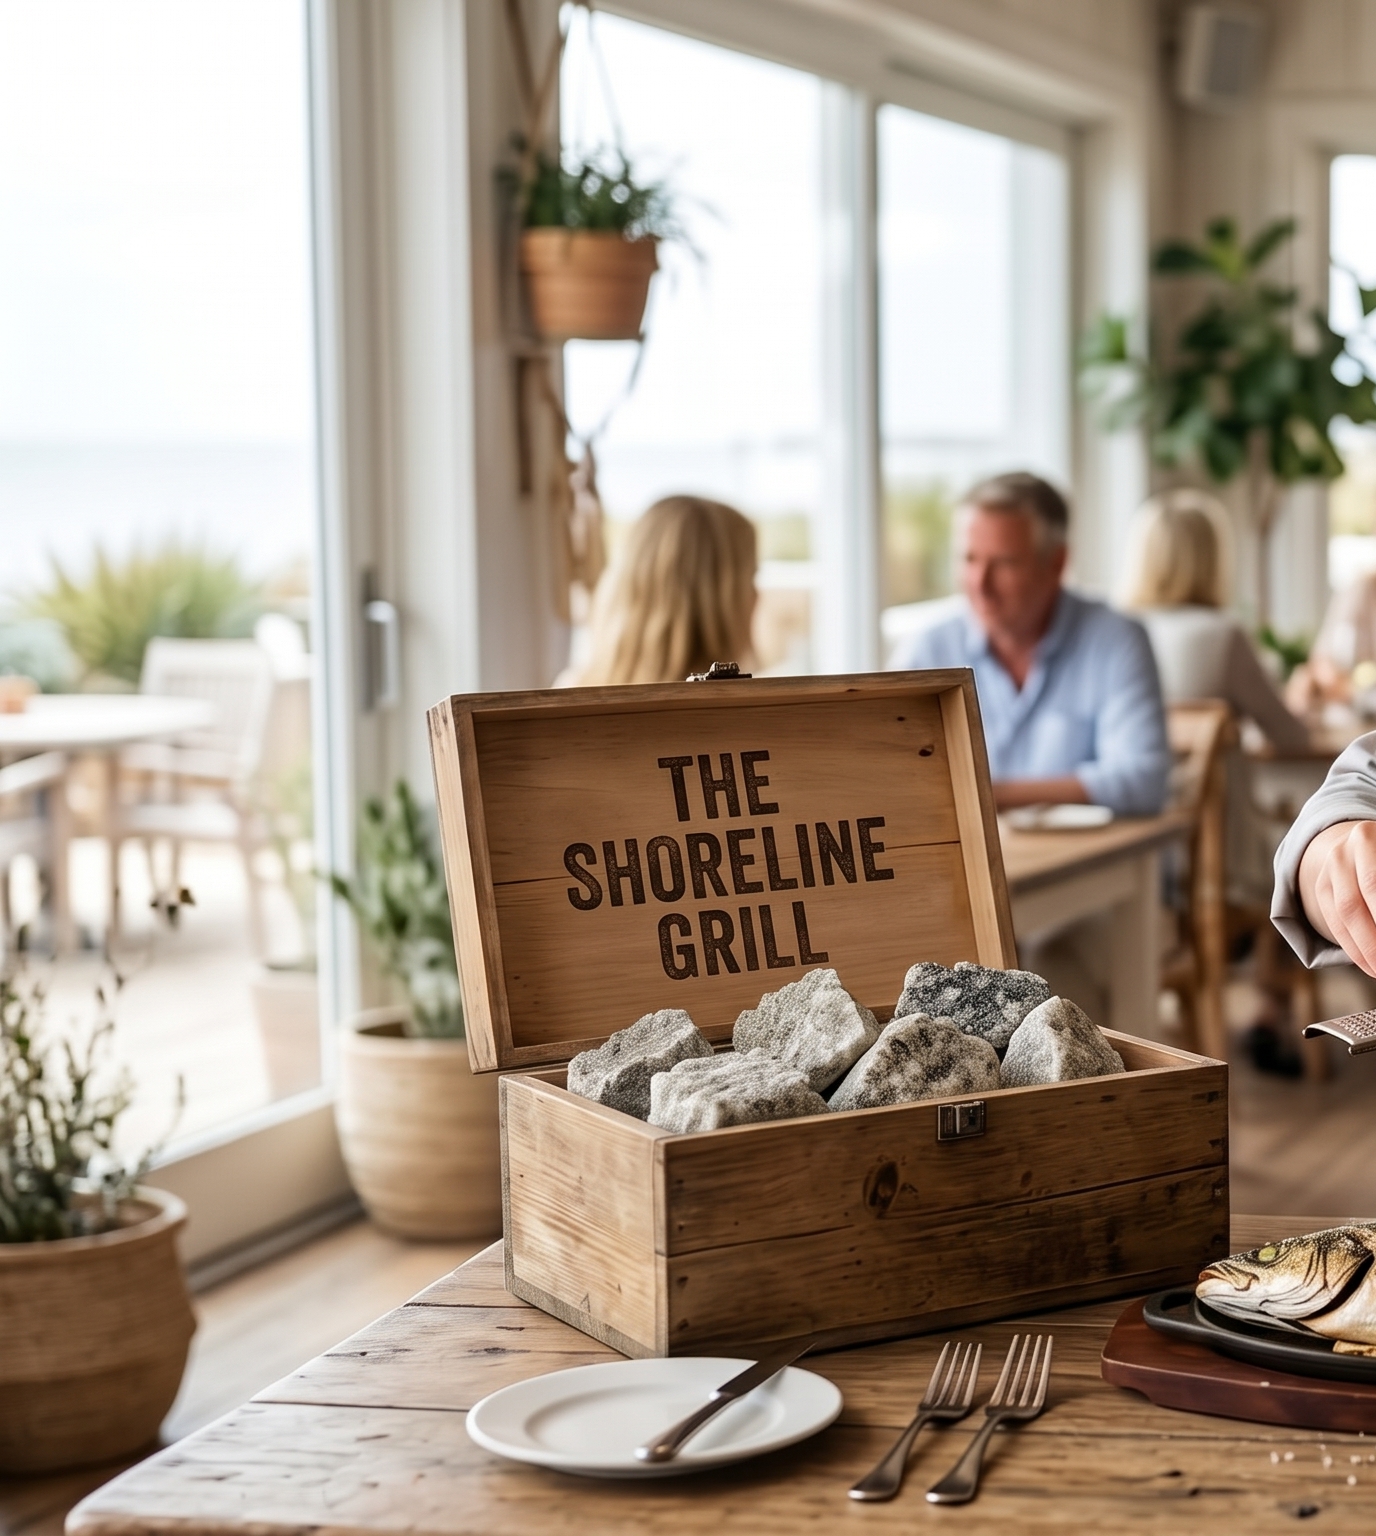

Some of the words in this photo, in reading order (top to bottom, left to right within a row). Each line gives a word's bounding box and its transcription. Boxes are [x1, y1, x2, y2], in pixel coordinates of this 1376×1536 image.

[658, 750, 779, 822] THE
[563, 816, 894, 911] SHORELINE
[657, 901, 829, 981] GRILL
